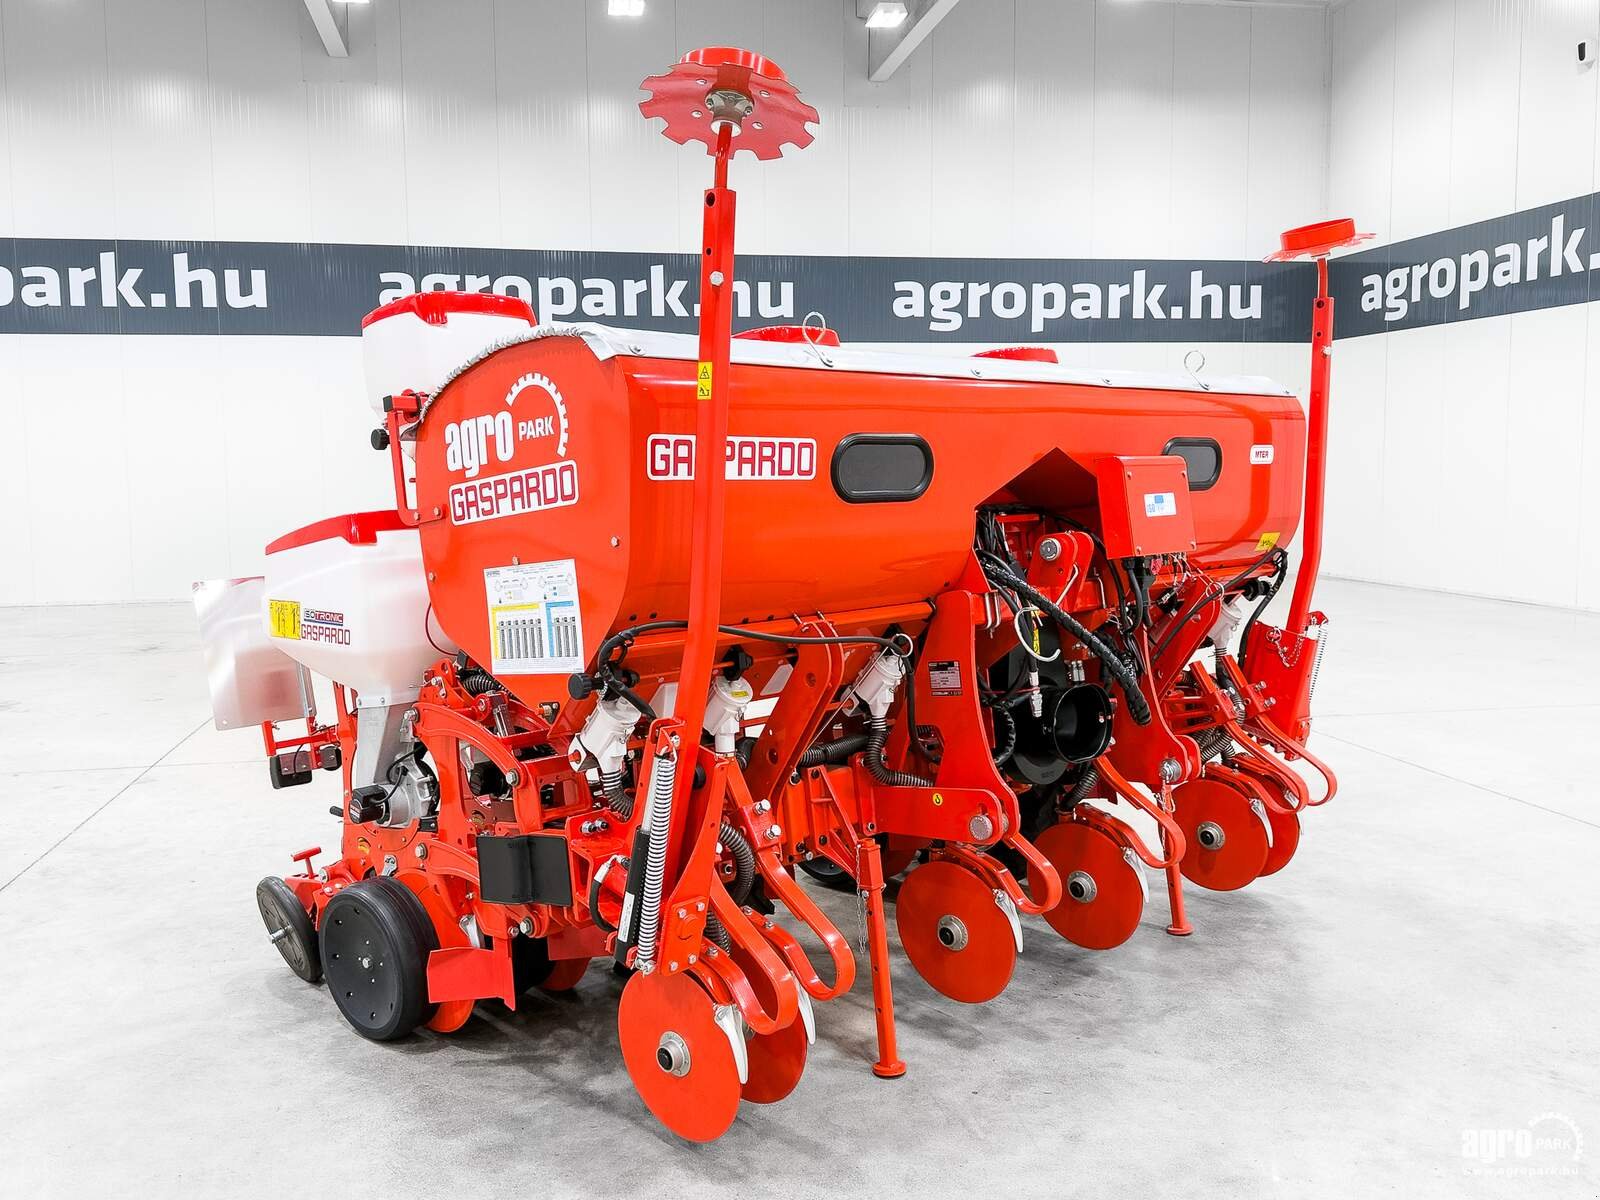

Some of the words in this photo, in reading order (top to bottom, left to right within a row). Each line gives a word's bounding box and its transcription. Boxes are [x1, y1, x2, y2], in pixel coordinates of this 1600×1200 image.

[892, 269, 1262, 333] agropark.hu
[444, 410, 515, 478] agro
[518, 415, 555, 441] PARK
[451, 464, 576, 522] GASPARDO
[301, 624, 351, 645] GASPARDO
